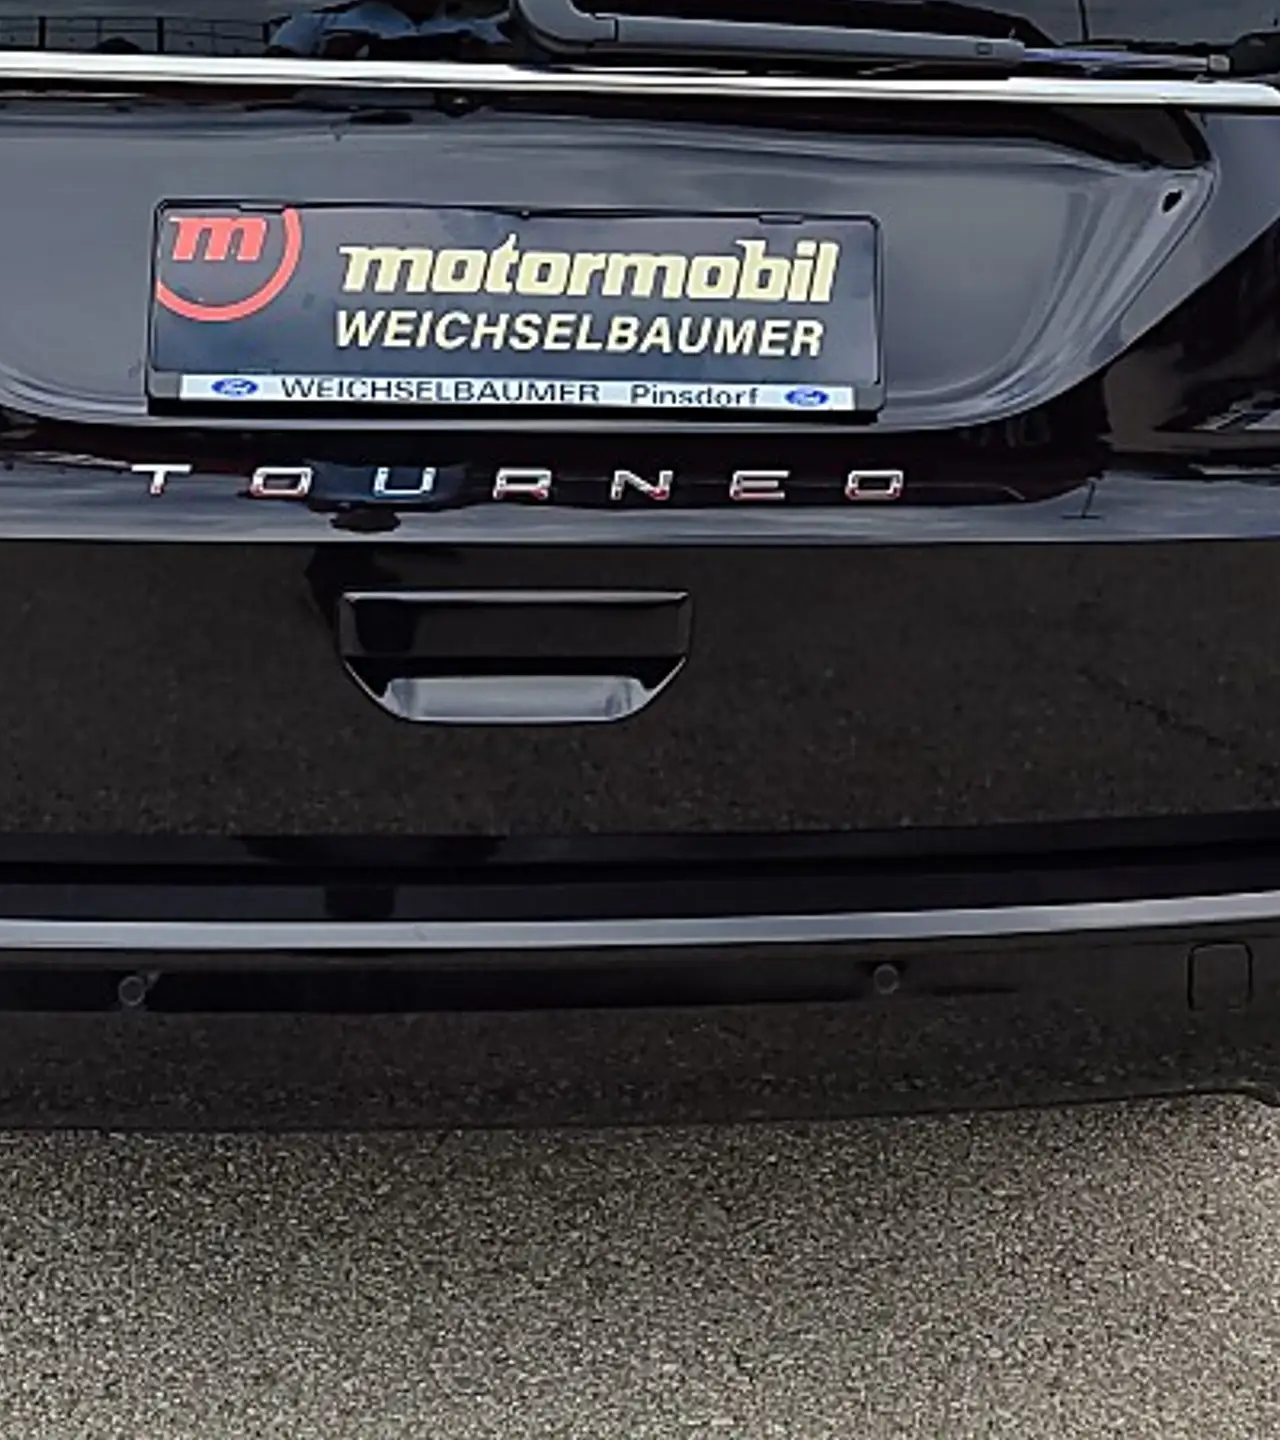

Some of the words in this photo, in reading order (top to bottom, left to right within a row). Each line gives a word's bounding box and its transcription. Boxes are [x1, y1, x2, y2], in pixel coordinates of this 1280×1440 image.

[170, 216, 268, 262] m
[338, 233, 840, 302] motormobil
[335, 310, 825, 358] WEICHSELBAUMER
[280, 376, 601, 404] WEICHSELBAUMER
[629, 383, 761, 408] Pinsdorf
[130, 462, 906, 502] TOURNEO
